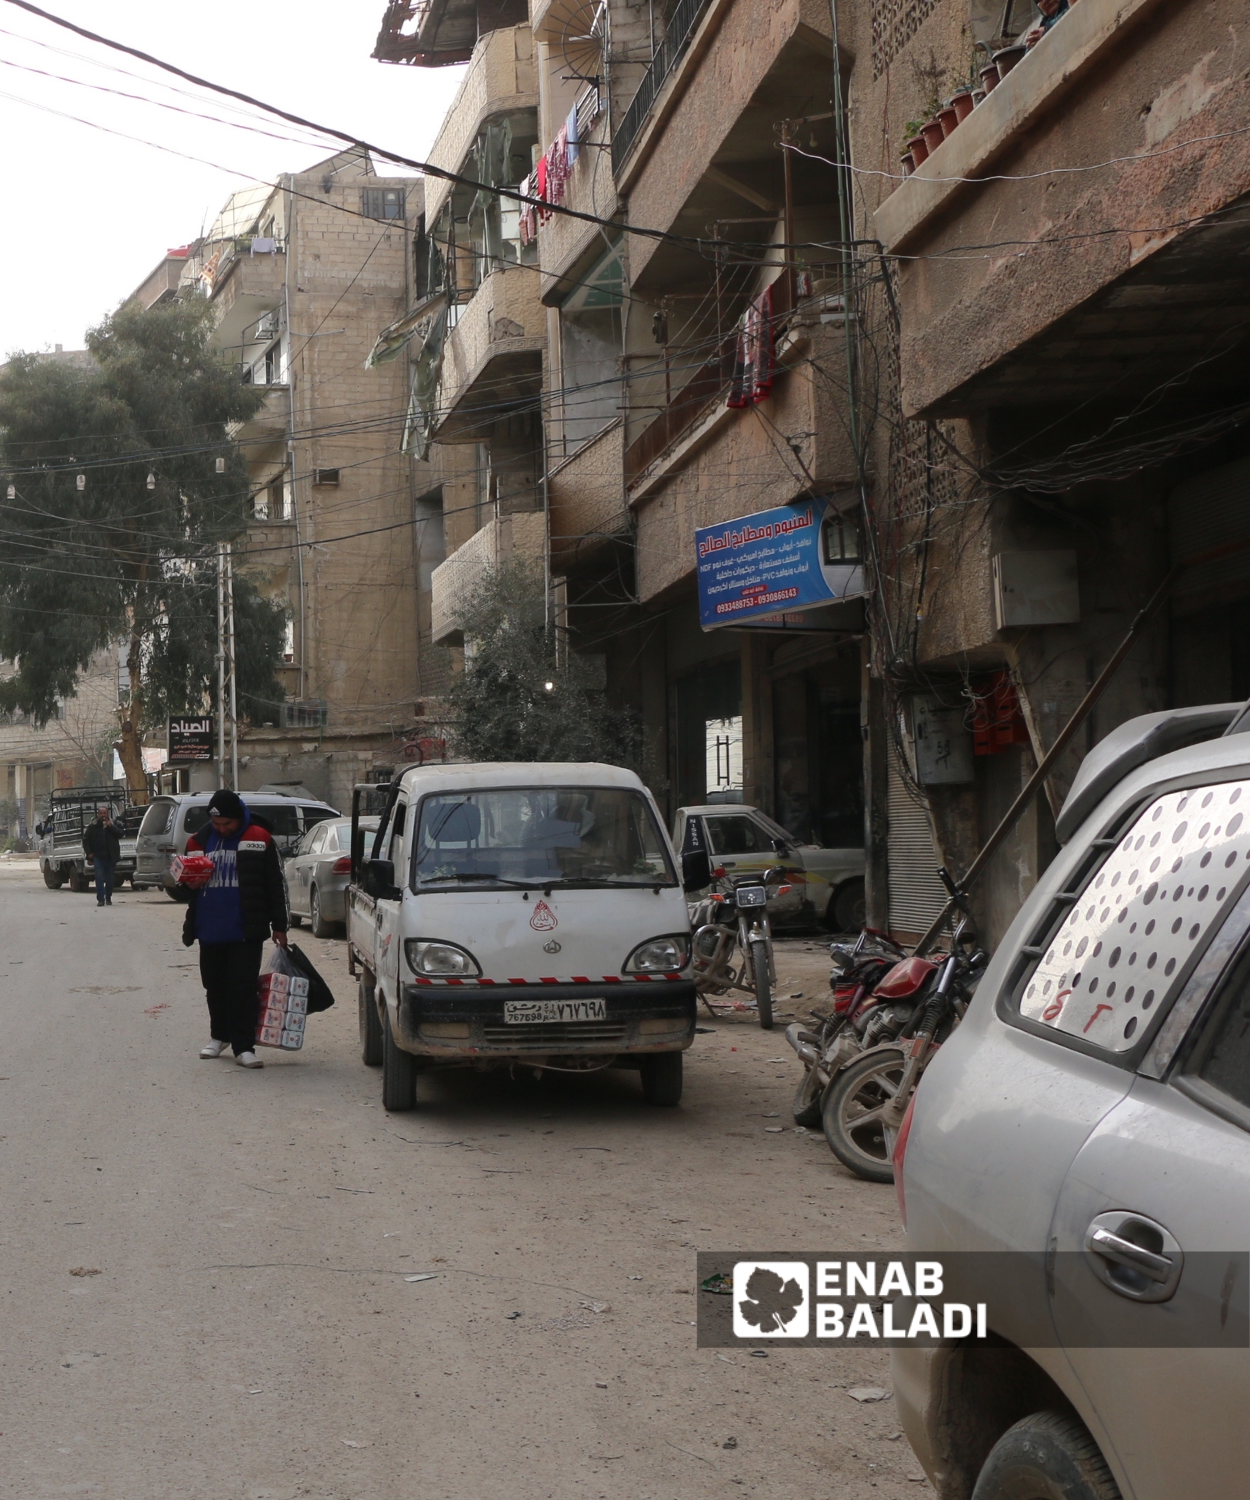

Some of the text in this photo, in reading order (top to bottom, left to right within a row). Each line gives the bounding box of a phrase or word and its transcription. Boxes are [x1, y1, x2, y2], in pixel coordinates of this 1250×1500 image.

[699, 531, 731, 558] الصالح
[732, 525, 773, 549] ومطابخ
[171, 720, 209, 737] الصياد
[690, 818, 699, 846] NISSAN
[507, 1003, 542, 1013] دمشق
[508, 1013, 542, 1022] 767698
[557, 1001, 606, 1020] ٧٦٧٦٩٨
